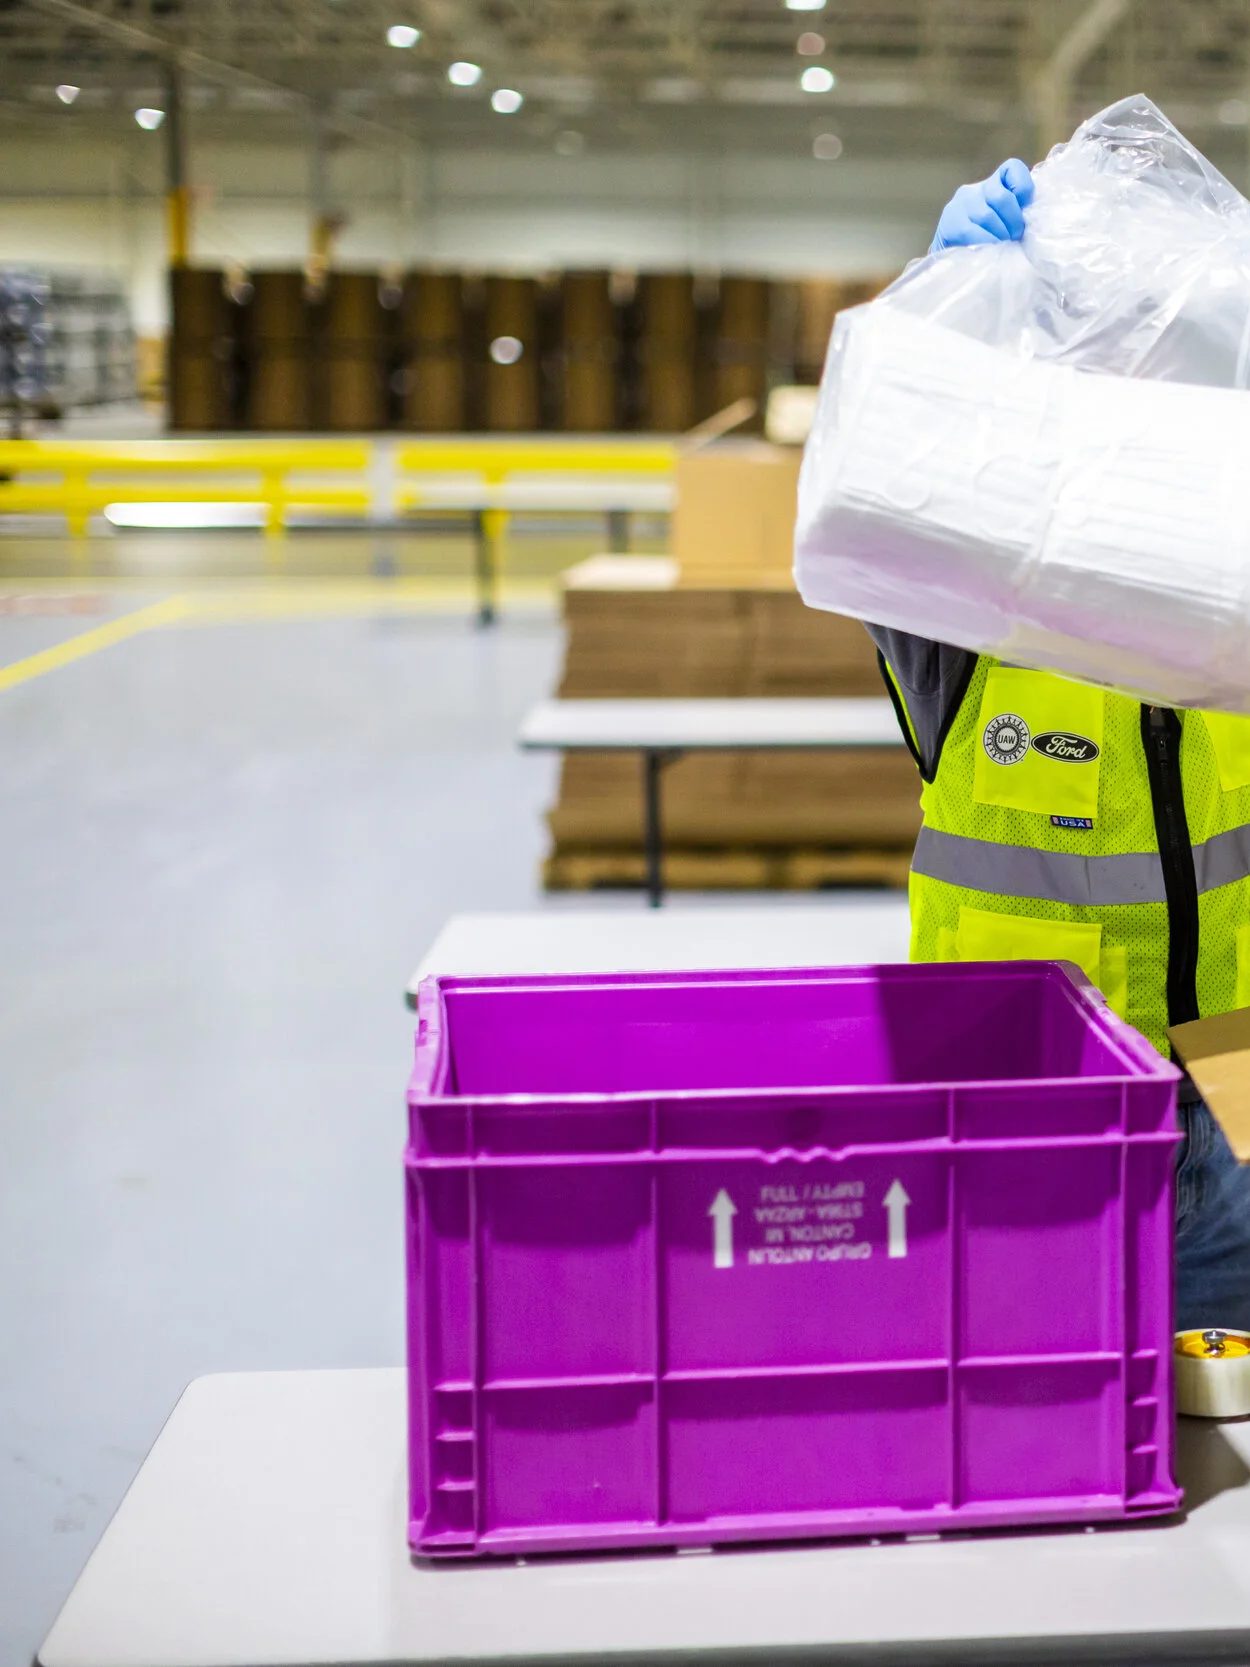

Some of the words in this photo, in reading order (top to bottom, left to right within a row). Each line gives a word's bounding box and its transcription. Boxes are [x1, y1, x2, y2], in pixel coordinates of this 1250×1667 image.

[998, 734, 1016, 745] UAW
[1045, 735, 1087, 759] Ford
[1060, 820, 1086, 828] USA
[748, 1247, 814, 1266] ANTOLIN
[815, 1241, 873, 1263] GRUPO
